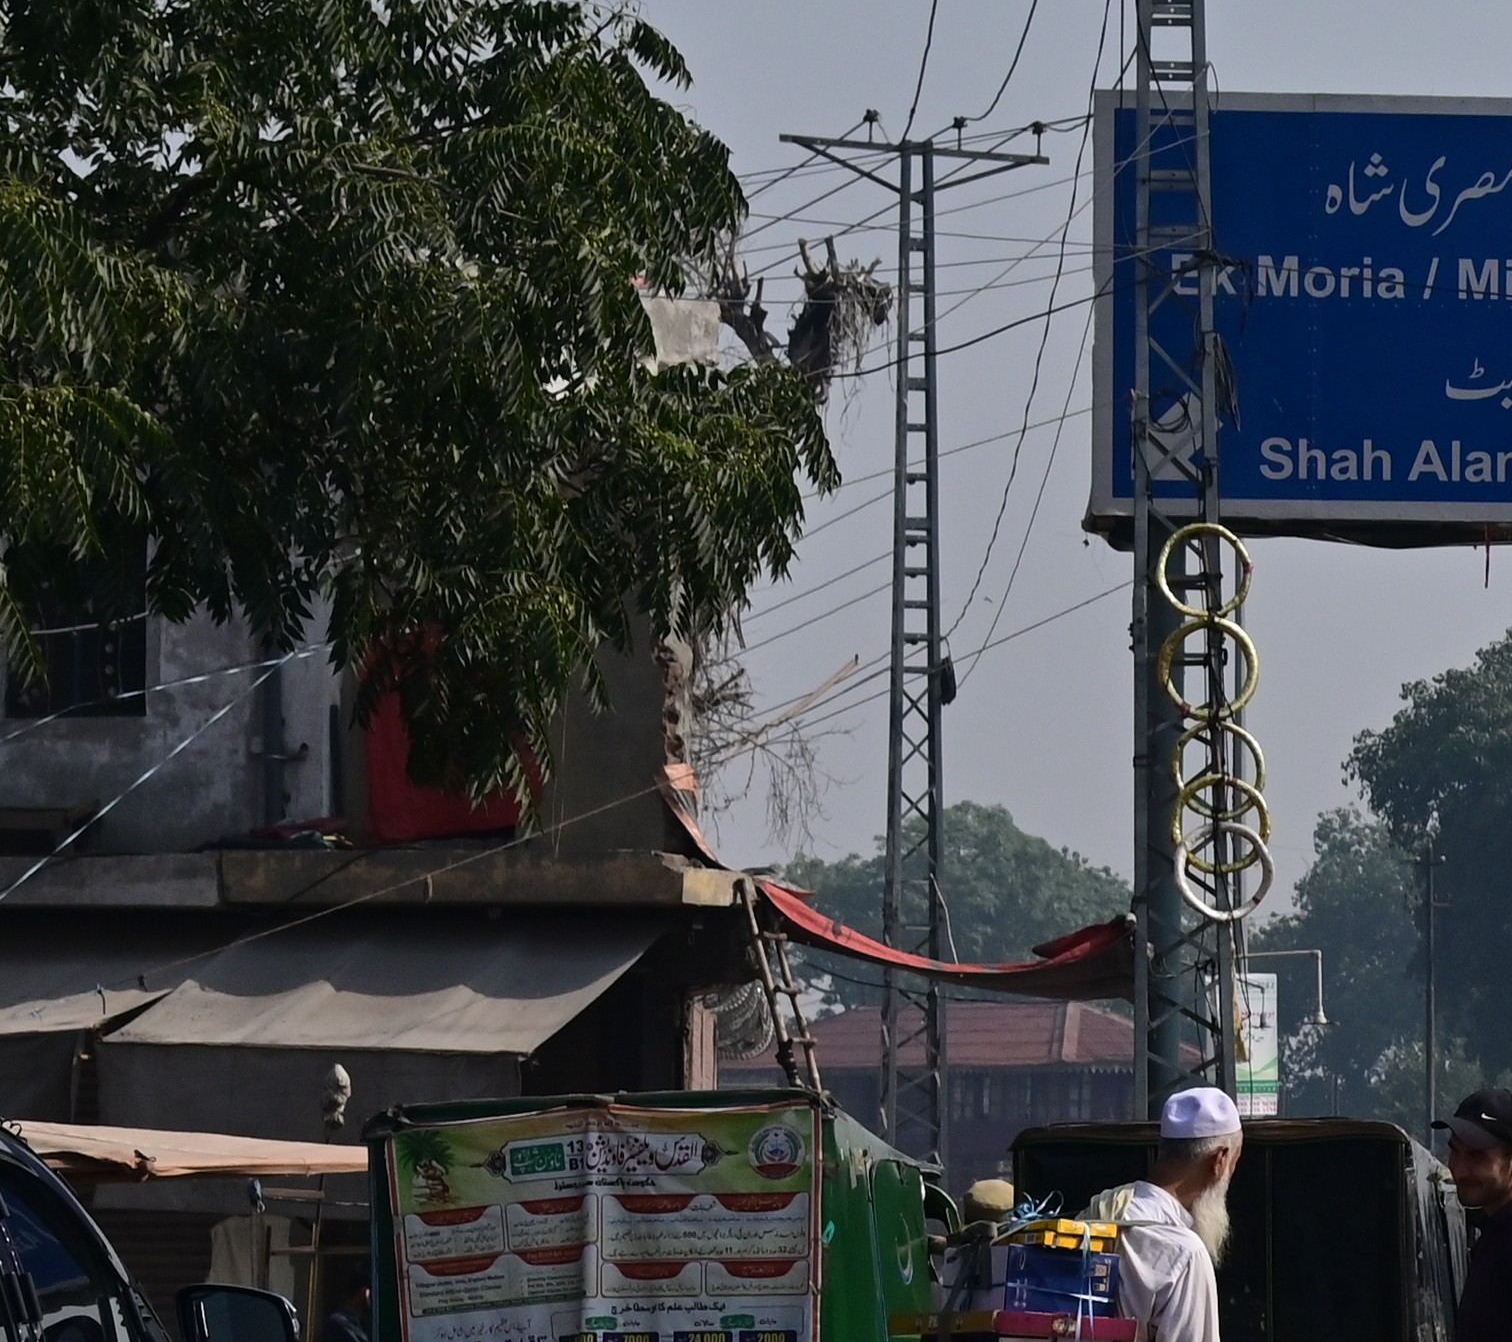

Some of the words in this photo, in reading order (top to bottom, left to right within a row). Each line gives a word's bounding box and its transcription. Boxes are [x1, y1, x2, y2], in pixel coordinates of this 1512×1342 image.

[1326, 154, 1394, 215] شاہ
[1171, 255, 1237, 295] Ek
[1258, 256, 1404, 299] Moria
[1423, 258, 1438, 299] /
[1260, 438, 1392, 481] Shah
[567, 1140, 584, 1154] 13
